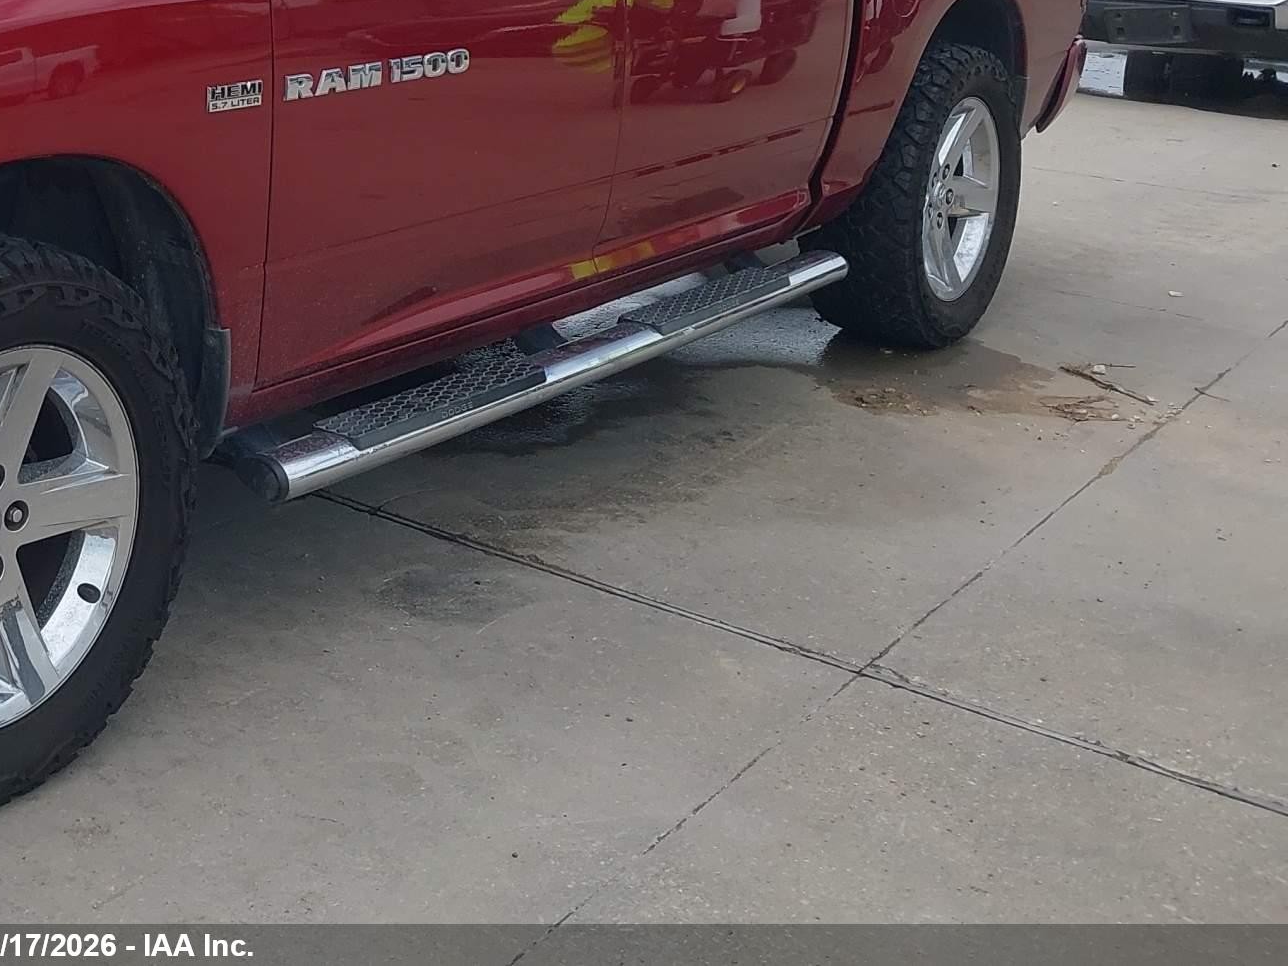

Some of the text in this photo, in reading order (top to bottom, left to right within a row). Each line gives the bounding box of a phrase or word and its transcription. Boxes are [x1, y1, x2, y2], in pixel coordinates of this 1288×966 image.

[283, 48, 470, 101] RAM 1500
[210, 81, 262, 100] HEMI
[211, 96, 260, 110] 5.7 LITER
